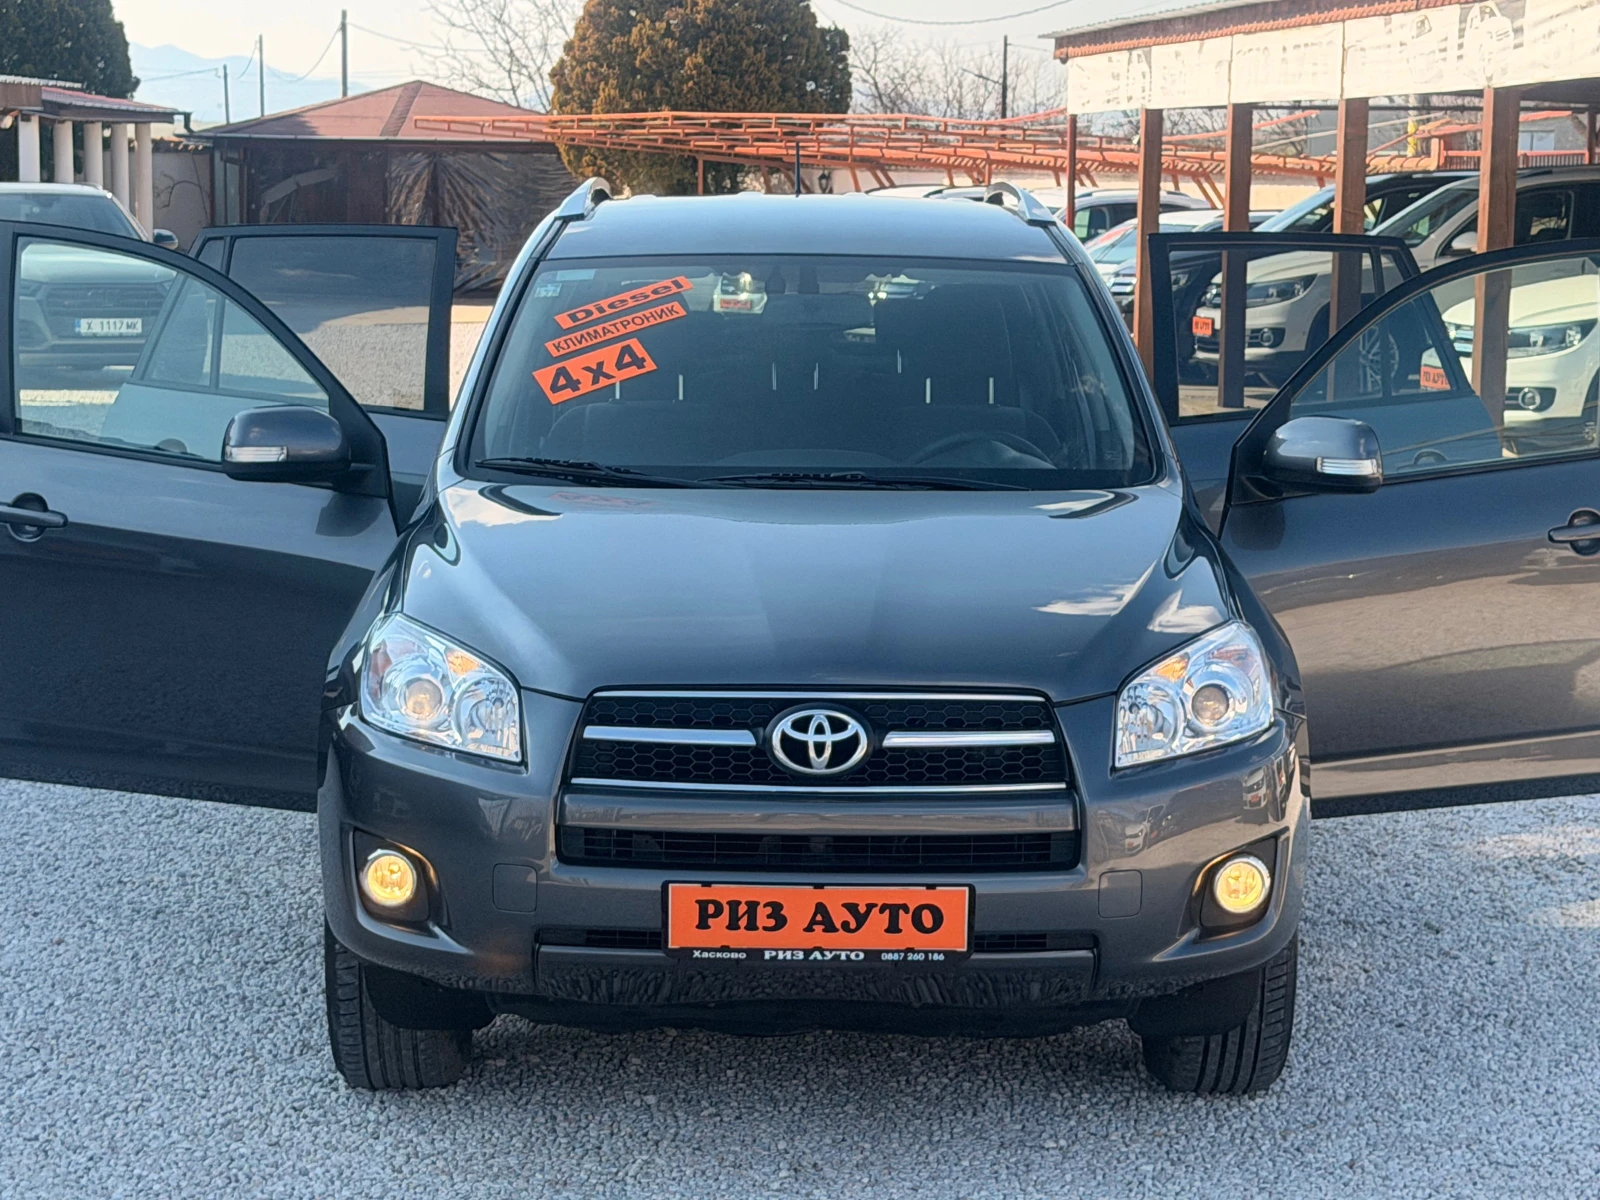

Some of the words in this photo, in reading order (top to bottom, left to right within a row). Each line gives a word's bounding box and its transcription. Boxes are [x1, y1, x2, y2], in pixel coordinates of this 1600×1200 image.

[567, 279, 684, 324] Diesel
[100, 320, 124, 331] 1117
[552, 304, 680, 352] КЛИМАТРОНИК
[695, 899, 788, 932] РИЗ
[802, 901, 944, 934] АУТО
[692, 949, 747, 959] Хасково
[763, 950, 804, 960] РИЗ
[808, 951, 865, 960] АУТО
[881, 952, 905, 961] 0887
[907, 952, 925, 961] 260
[928, 952, 945, 961] 186
